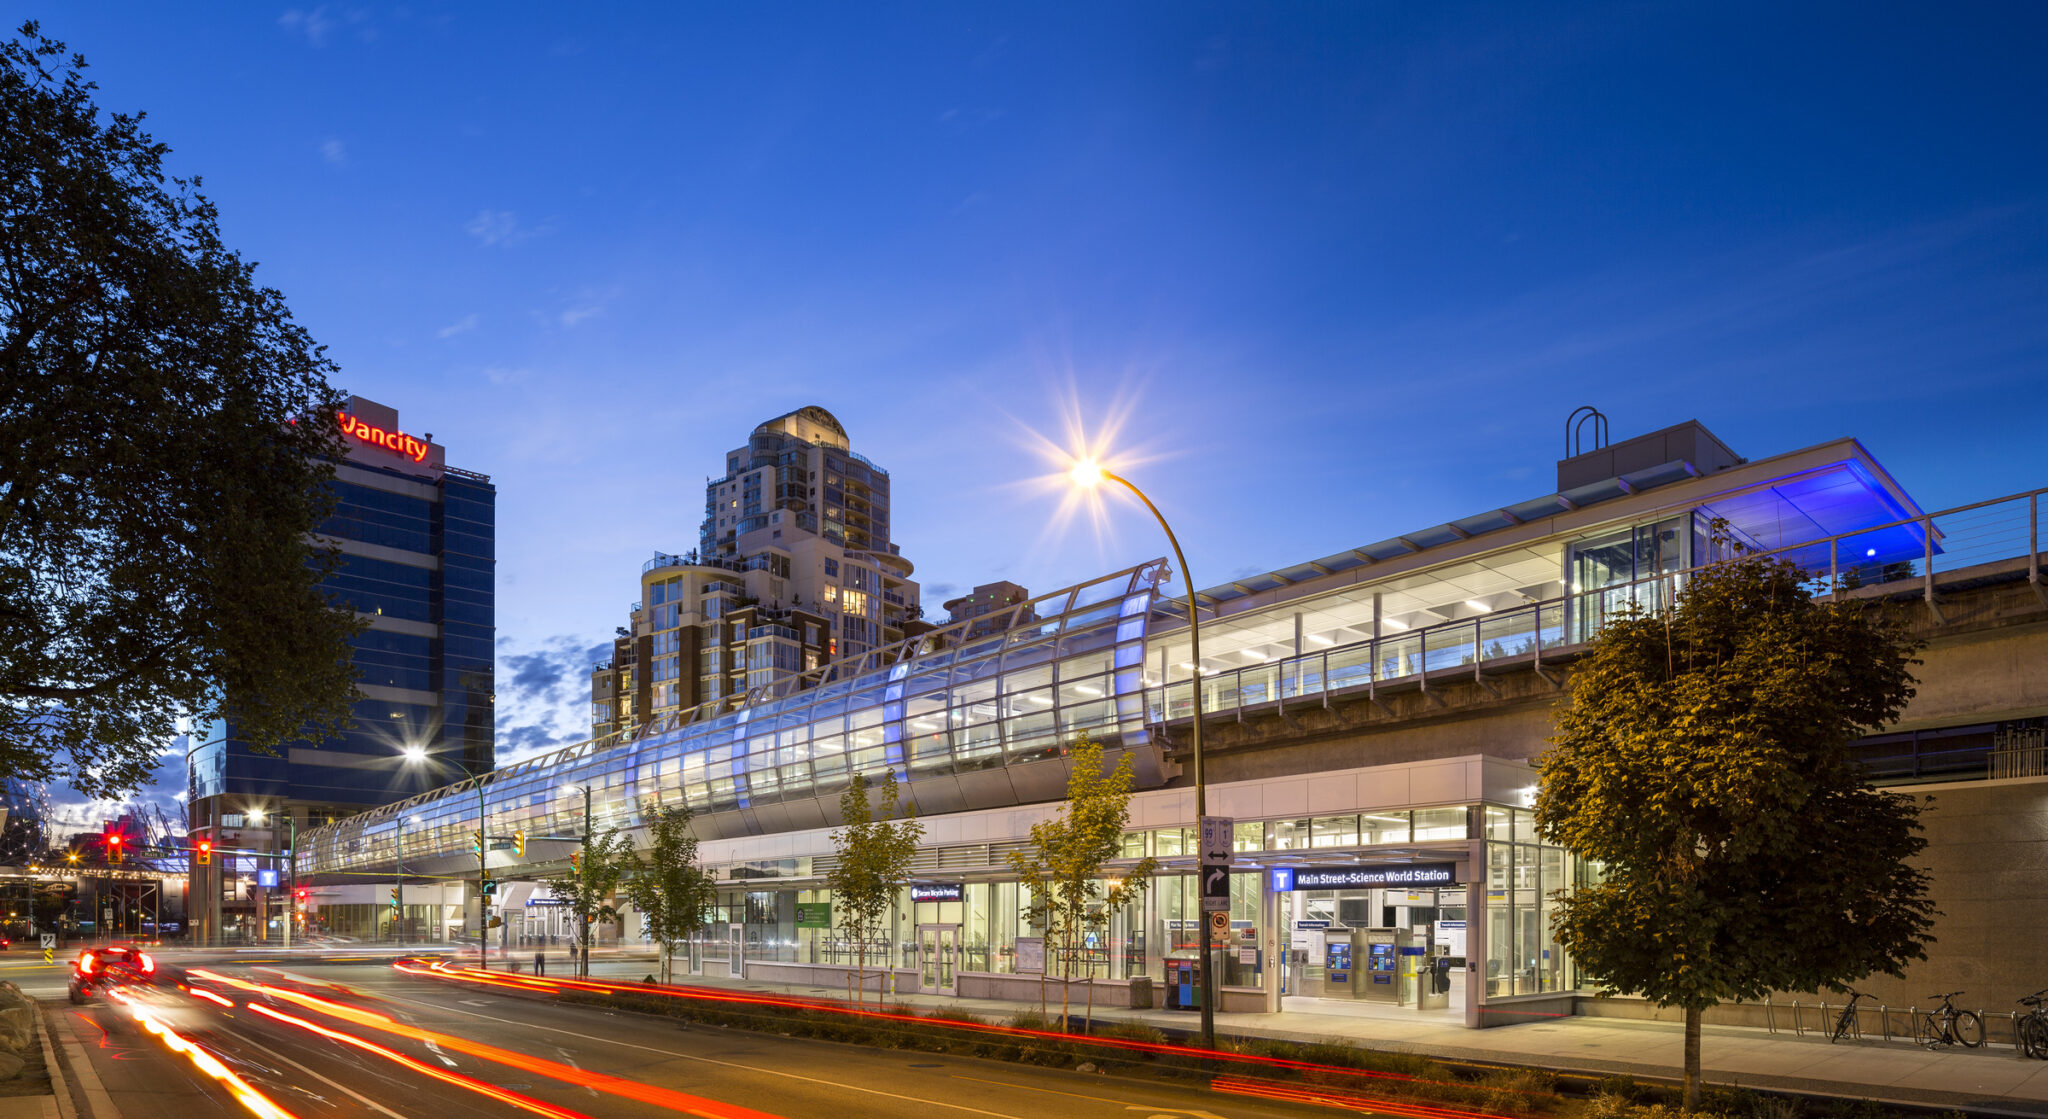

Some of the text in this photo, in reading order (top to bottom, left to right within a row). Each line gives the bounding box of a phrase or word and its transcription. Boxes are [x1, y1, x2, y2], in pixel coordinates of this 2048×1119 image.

[339, 412, 427, 462] Vancity
[1204, 828, 1213, 839] 99
[1223, 829, 1227, 839] 1
[263, 873, 274, 885] T
[1276, 873, 1288, 889] T
[1298, 874, 1318, 885] Main
[1386, 871, 1412, 882] World
[1414, 870, 1449, 881] Station
[931, 889, 943, 897] Bicycle
[944, 889, 959, 897] Parking
